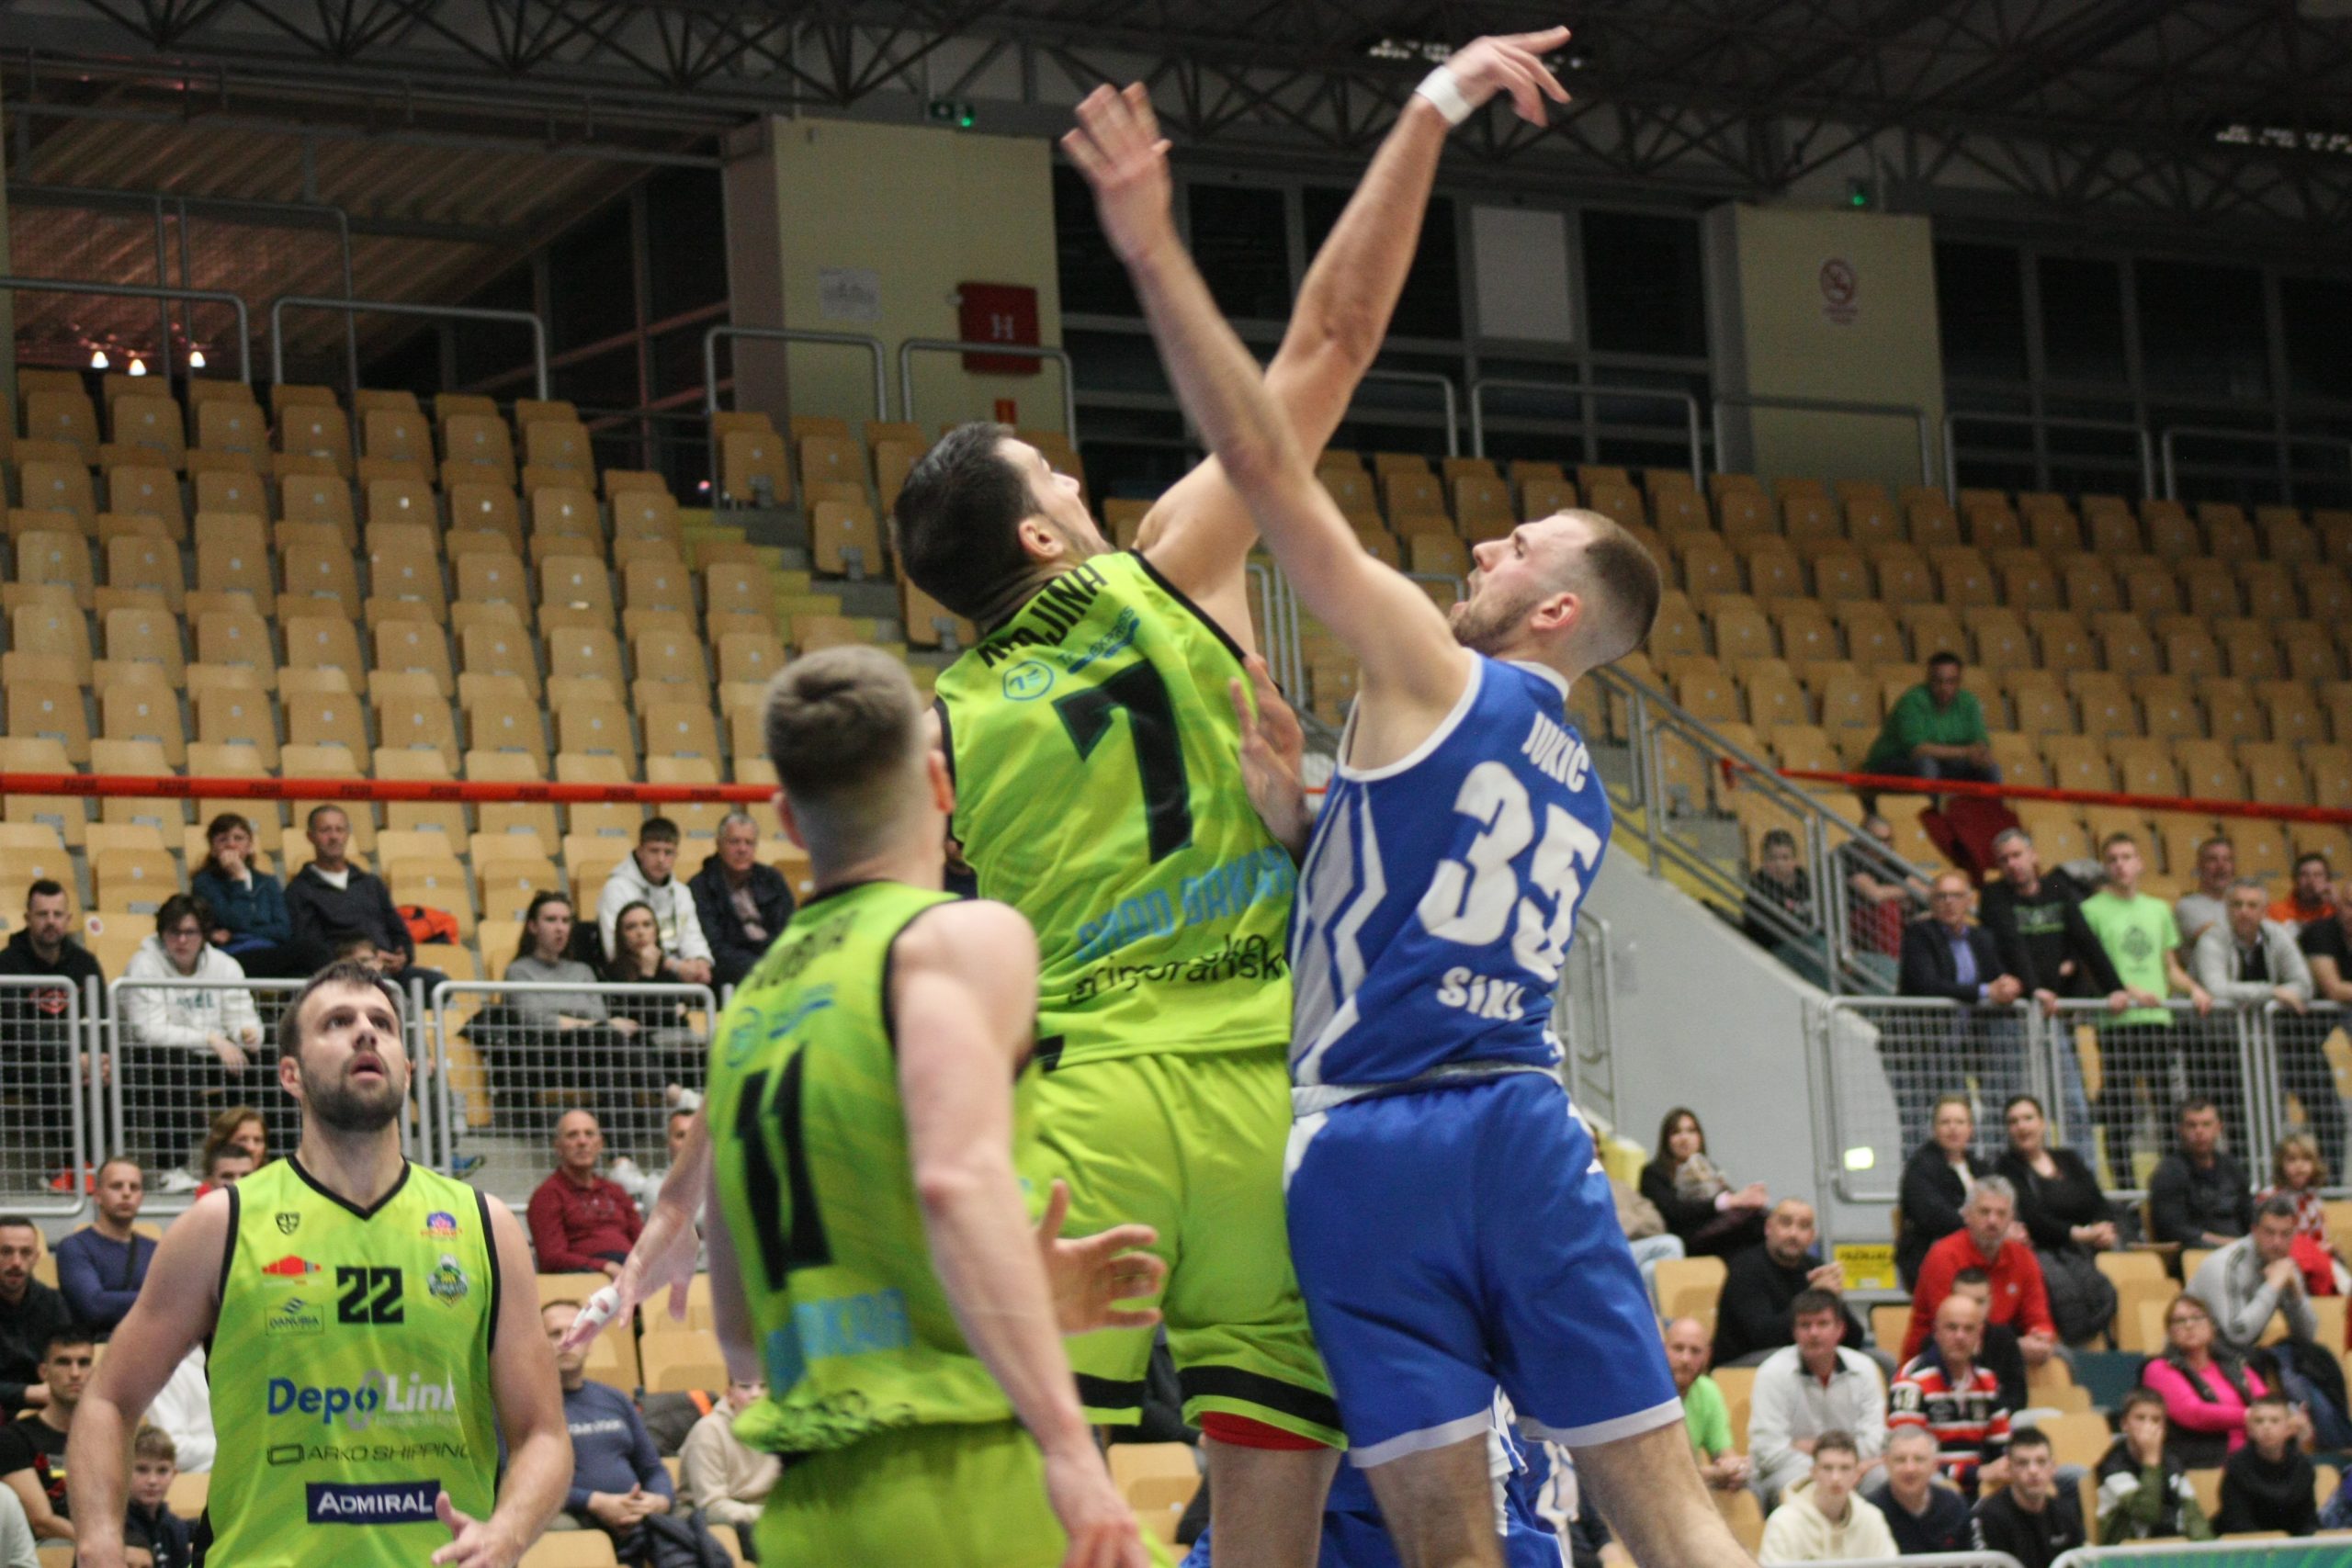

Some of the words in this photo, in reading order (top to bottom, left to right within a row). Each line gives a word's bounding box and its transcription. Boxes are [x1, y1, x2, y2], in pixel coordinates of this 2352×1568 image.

[1050, 657, 1193, 865] 7
[1417, 760, 1602, 984] 35
[336, 1265, 405, 1325] 22
[306, 1444, 369, 1462] ARKO
[317, 1490, 434, 1516] ADMIRAL
